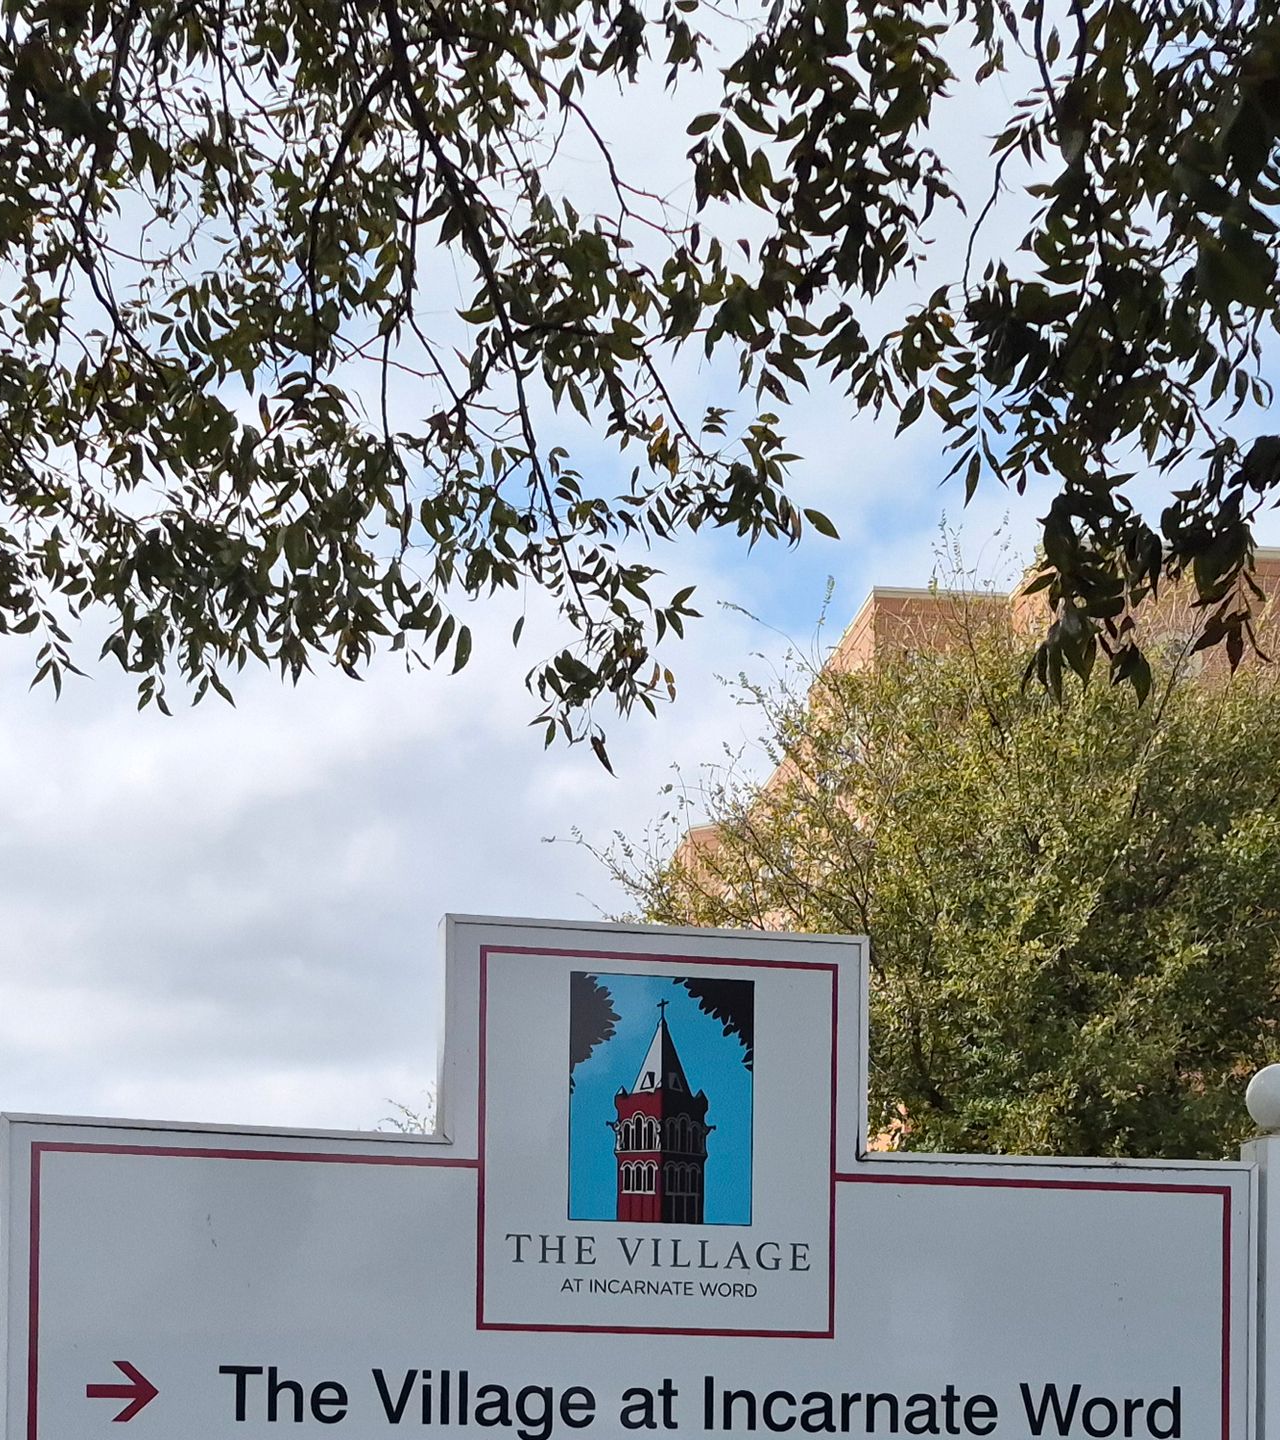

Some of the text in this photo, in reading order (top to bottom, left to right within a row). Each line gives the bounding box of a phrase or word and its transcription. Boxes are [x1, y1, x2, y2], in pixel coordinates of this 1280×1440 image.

[505, 1233, 811, 1272] THE VILLAGE
[560, 1278, 758, 1299] AT INCARNATE WORD
[219, 1366, 347, 1424] The
[620, 1379, 678, 1429] at
[704, 1376, 997, 1437] Incarnate
[1020, 1383, 1182, 1440] Word
